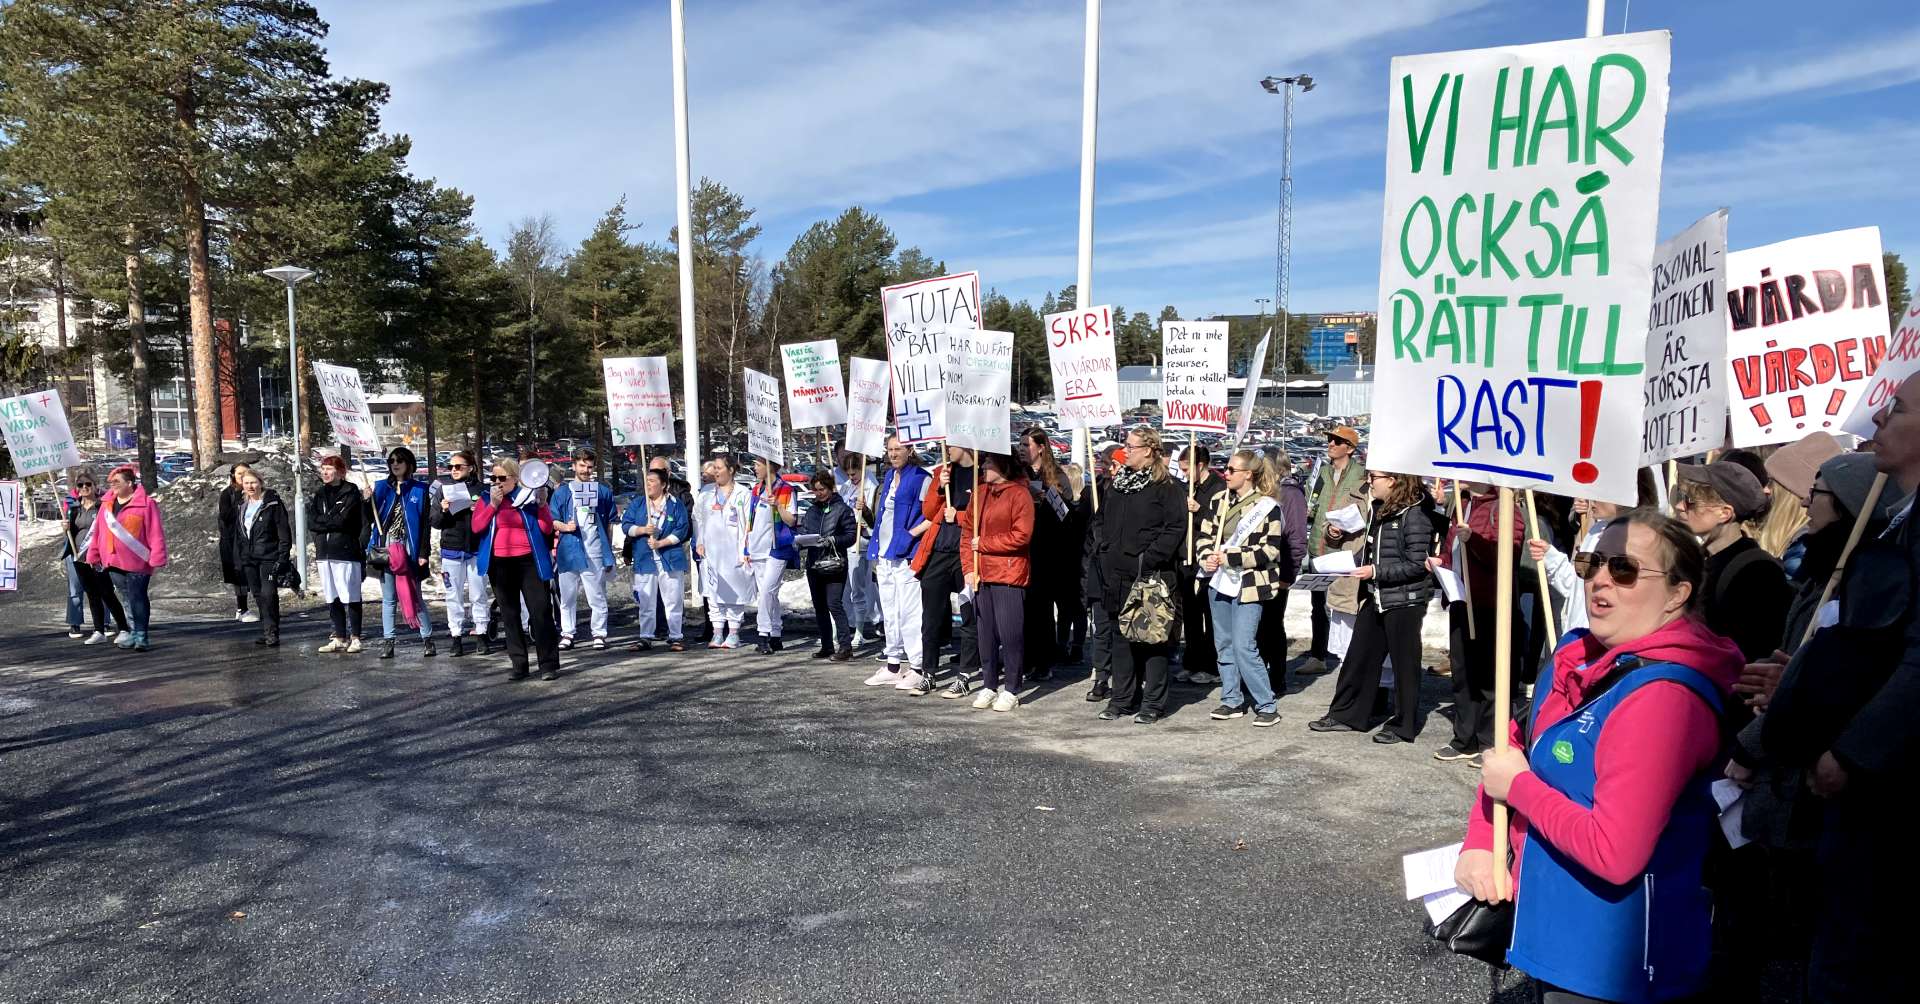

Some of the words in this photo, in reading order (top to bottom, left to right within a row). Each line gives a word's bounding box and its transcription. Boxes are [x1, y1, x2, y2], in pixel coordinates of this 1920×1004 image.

[1402, 72, 1464, 176] VI
[1487, 53, 1648, 171] HAR
[1400, 171, 1611, 281] OCKSÅ
[1651, 241, 1721, 300] RSONAL-
[902, 280, 979, 325] TUTA!
[1649, 277, 1715, 332] OLITIKEN
[1727, 262, 1882, 332] VÅRDA
[887, 321, 913, 348] FÖR
[1051, 307, 1112, 348] SKR!
[1169, 326, 1189, 345] Det
[1205, 328, 1223, 341] inte
[1389, 273, 1509, 369] RÄTT
[1517, 293, 1645, 376] TILL
[908, 326, 945, 358] BÄT
[949, 336, 972, 353] HAR
[975, 341, 989, 355] DU
[992, 341, 1012, 357] FÅTT
[1165, 344, 1195, 356] betalar
[1660, 330, 1689, 371] ÄR
[947, 353, 961, 365] DIN
[966, 356, 1011, 371] OPERATION
[1055, 359, 1069, 377] VI
[1071, 354, 1113, 377] VÅRDAR
[1167, 359, 1209, 369] resurser,
[1731, 335, 1887, 400] VÅRDEN
[318, 367, 341, 387] VEM
[745, 373, 753, 388] VI
[758, 379, 775, 397] VILL
[895, 359, 946, 396] VILLK
[947, 370, 964, 386] INOM
[1065, 377, 1098, 397] ERA
[1165, 371, 1181, 384] får
[1186, 373, 1195, 383] ni
[946, 390, 1007, 408] VÅRDGARANTIN?
[1166, 385, 1195, 397] betala
[0, 399, 33, 419] VEM
[1059, 401, 1117, 419] ANHÖRIGA
[11, 433, 35, 446] DIG
[1436, 373, 1604, 485] RAST!
